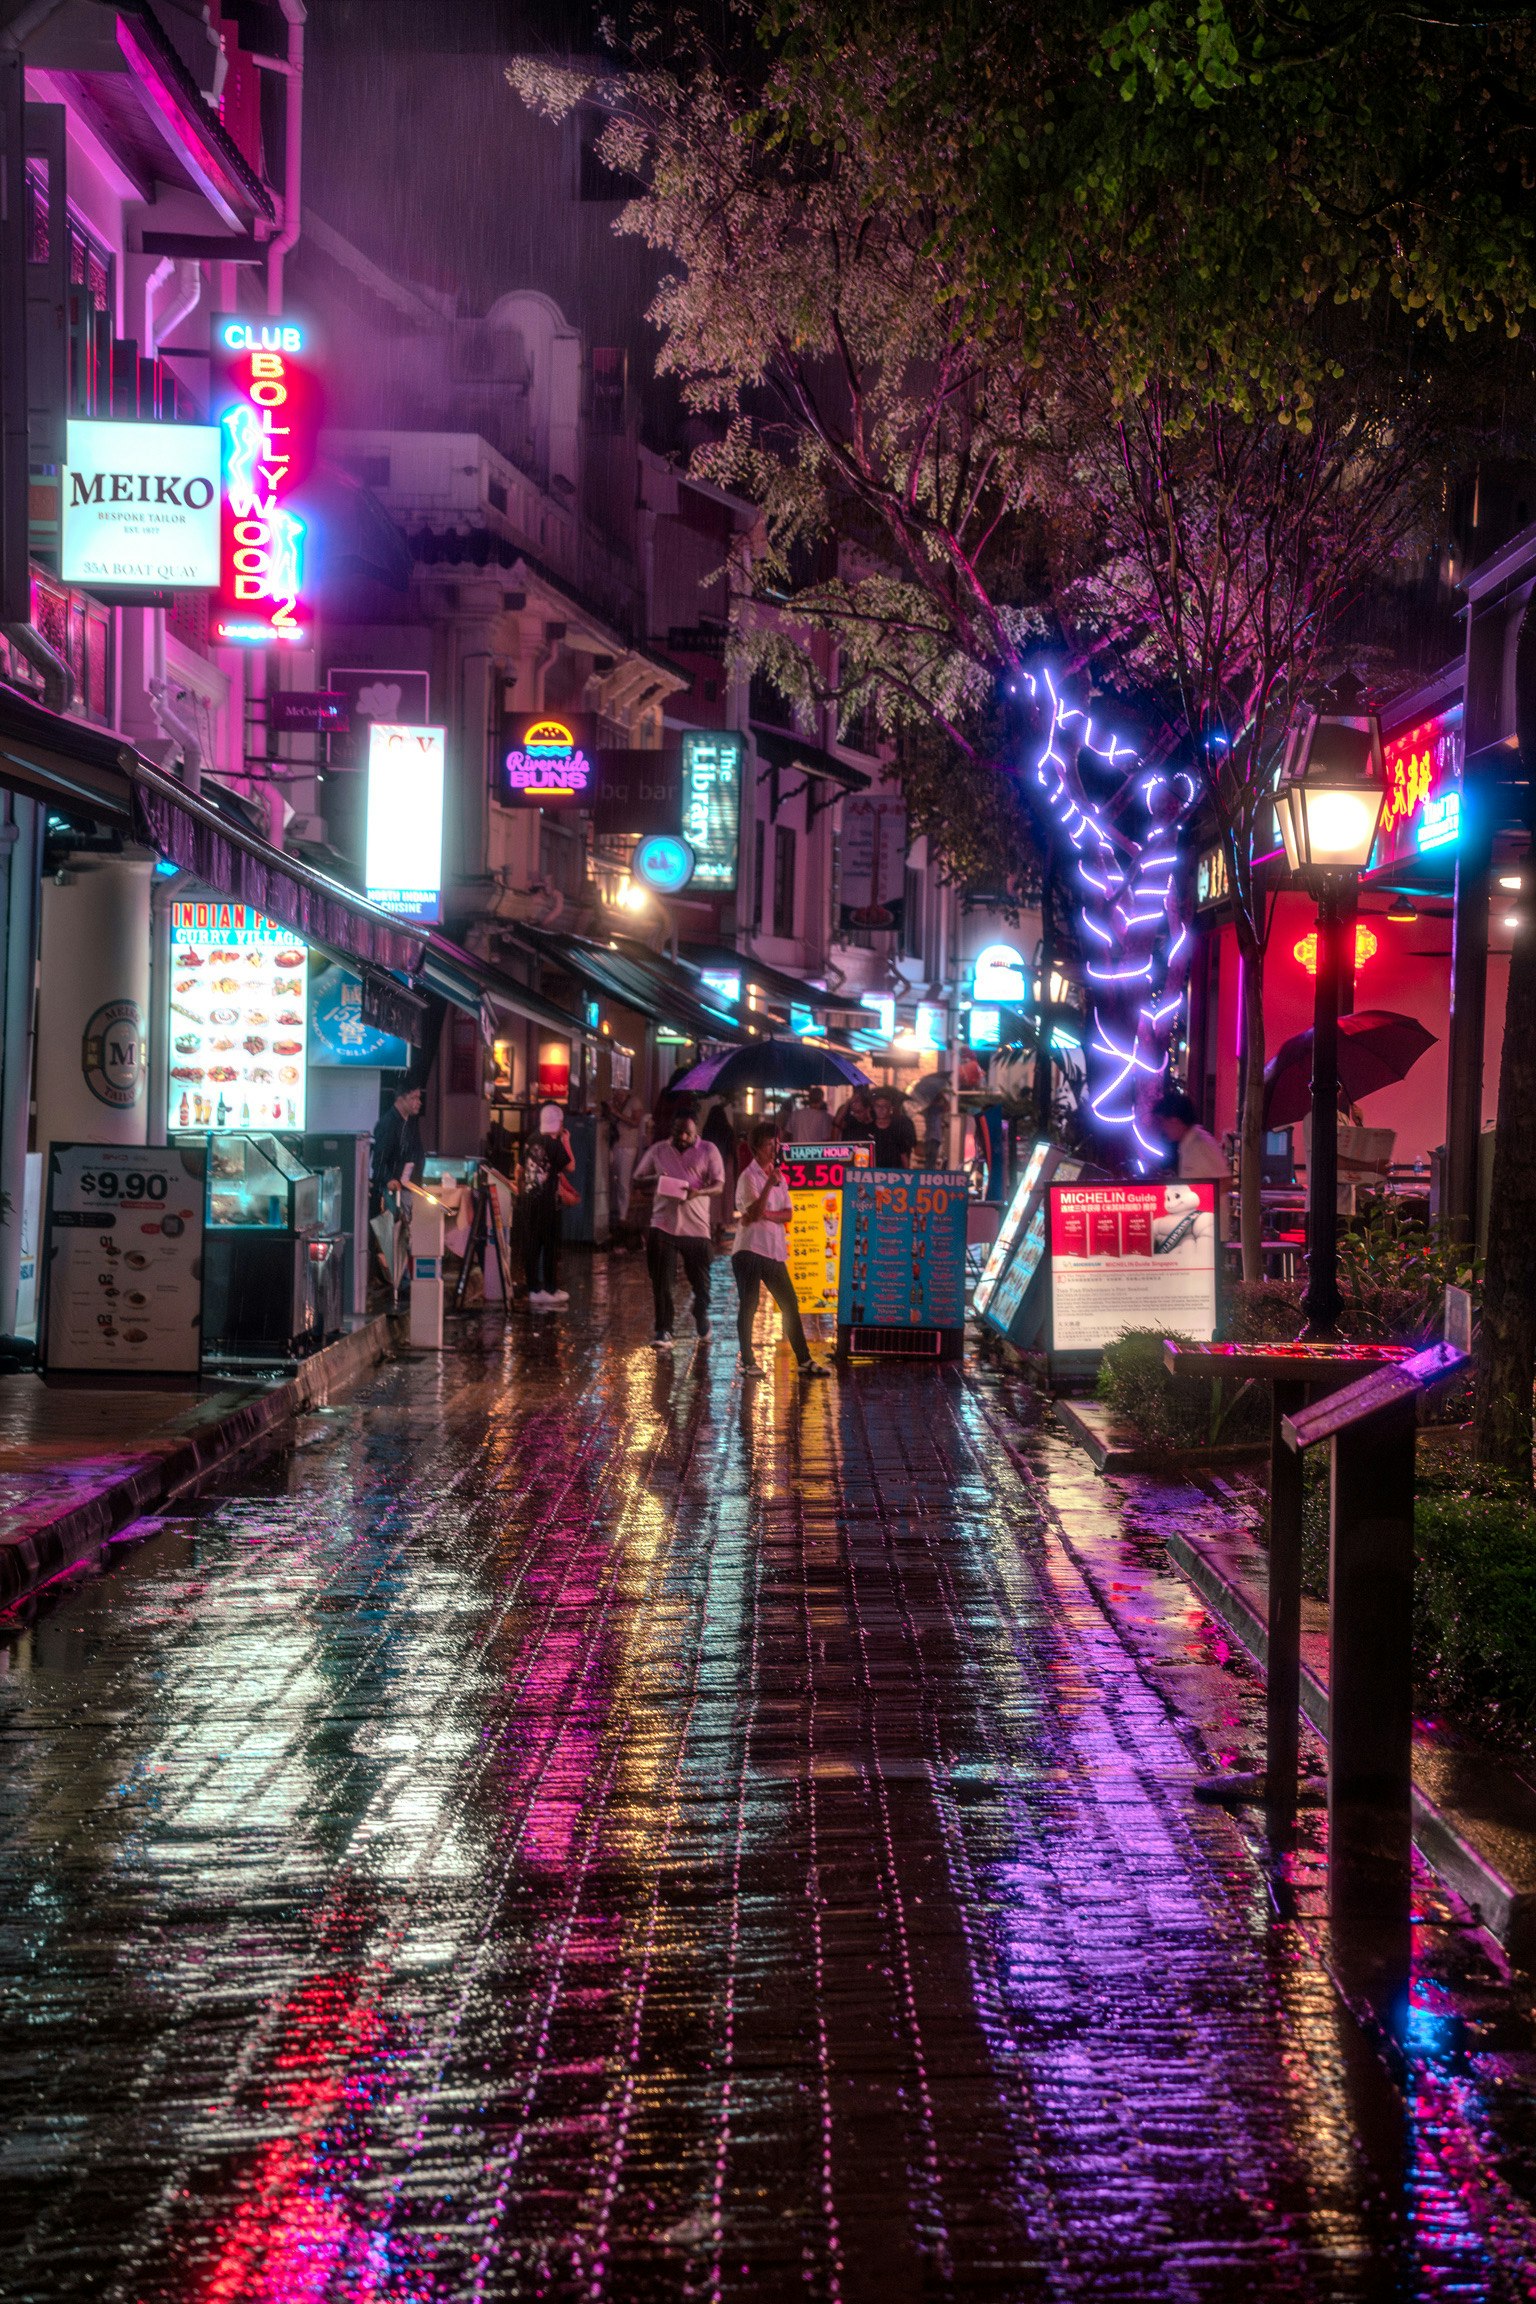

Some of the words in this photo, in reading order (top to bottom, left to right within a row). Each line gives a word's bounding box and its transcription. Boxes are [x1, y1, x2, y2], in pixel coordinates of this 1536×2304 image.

[224, 325, 302, 351] CLUB
[70, 472, 214, 510] MEIKO
[228, 352, 291, 600] BOLLYWOOD
[271, 596, 297, 627] 2
[98, 512, 145, 523] BESPOKE
[148, 514, 186, 524] TAILOR
[113, 563, 153, 576] BOAT
[157, 565, 198, 580] QUAY
[506, 750, 590, 773] Riverside
[720, 747, 736, 782] The
[510, 771, 587, 789] BUNS
[683, 746, 717, 849] Library
[367, 889, 400, 901] NORTH
[402, 890, 437, 903] INDIAN
[173, 902, 246, 928] INDIAN
[380, 901, 422, 913] CUISINE
[176, 928, 230, 944] CURRY
[109, 1042, 136, 1066] M
[791, 1147, 822, 1158] HAPPY
[823, 1147, 850, 1158] HOUR
[846, 1170, 914, 1186] HAPPY
[919, 1174, 968, 1187] HOUR
[1060, 1193, 1125, 1204] MICHELIN
[1127, 1194, 1157, 1202] Guide
